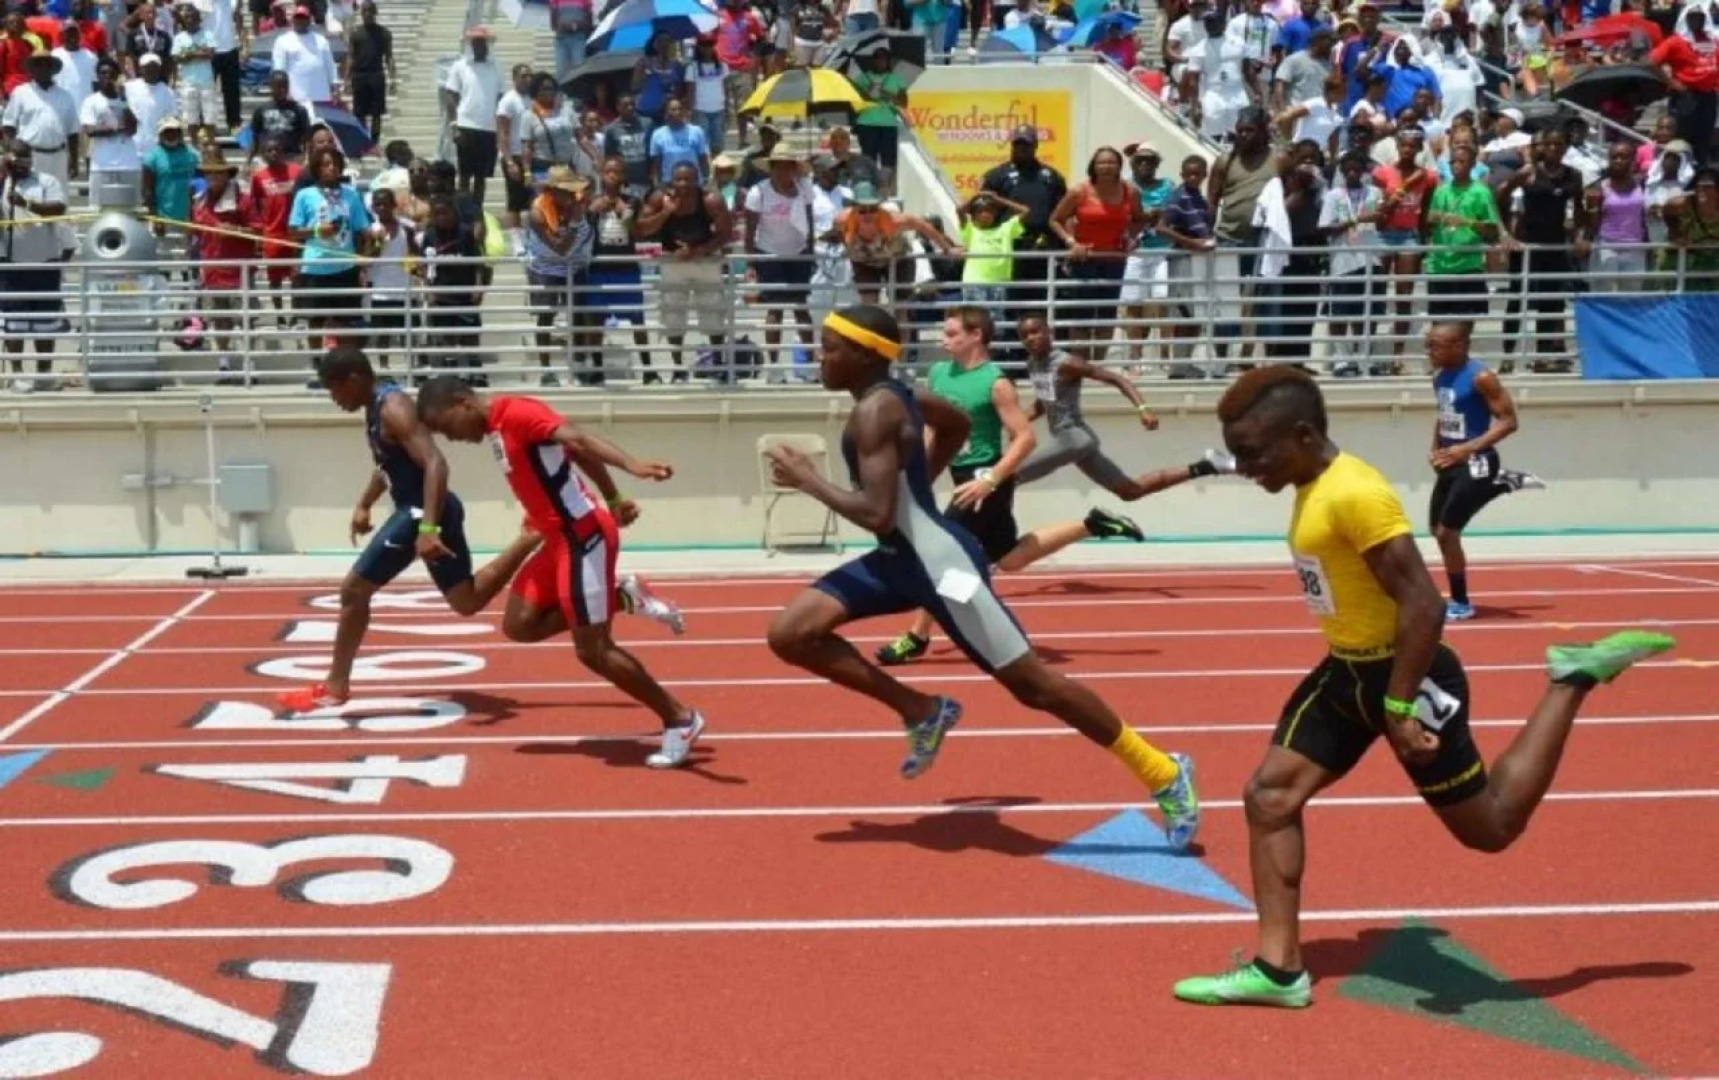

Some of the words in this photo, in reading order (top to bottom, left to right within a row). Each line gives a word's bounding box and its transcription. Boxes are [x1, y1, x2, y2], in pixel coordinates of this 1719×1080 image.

[909, 99, 1038, 146] Wonderful
[150, 754, 468, 804] 4
[55, 833, 455, 910] 3
[0, 958, 392, 1077] 2
